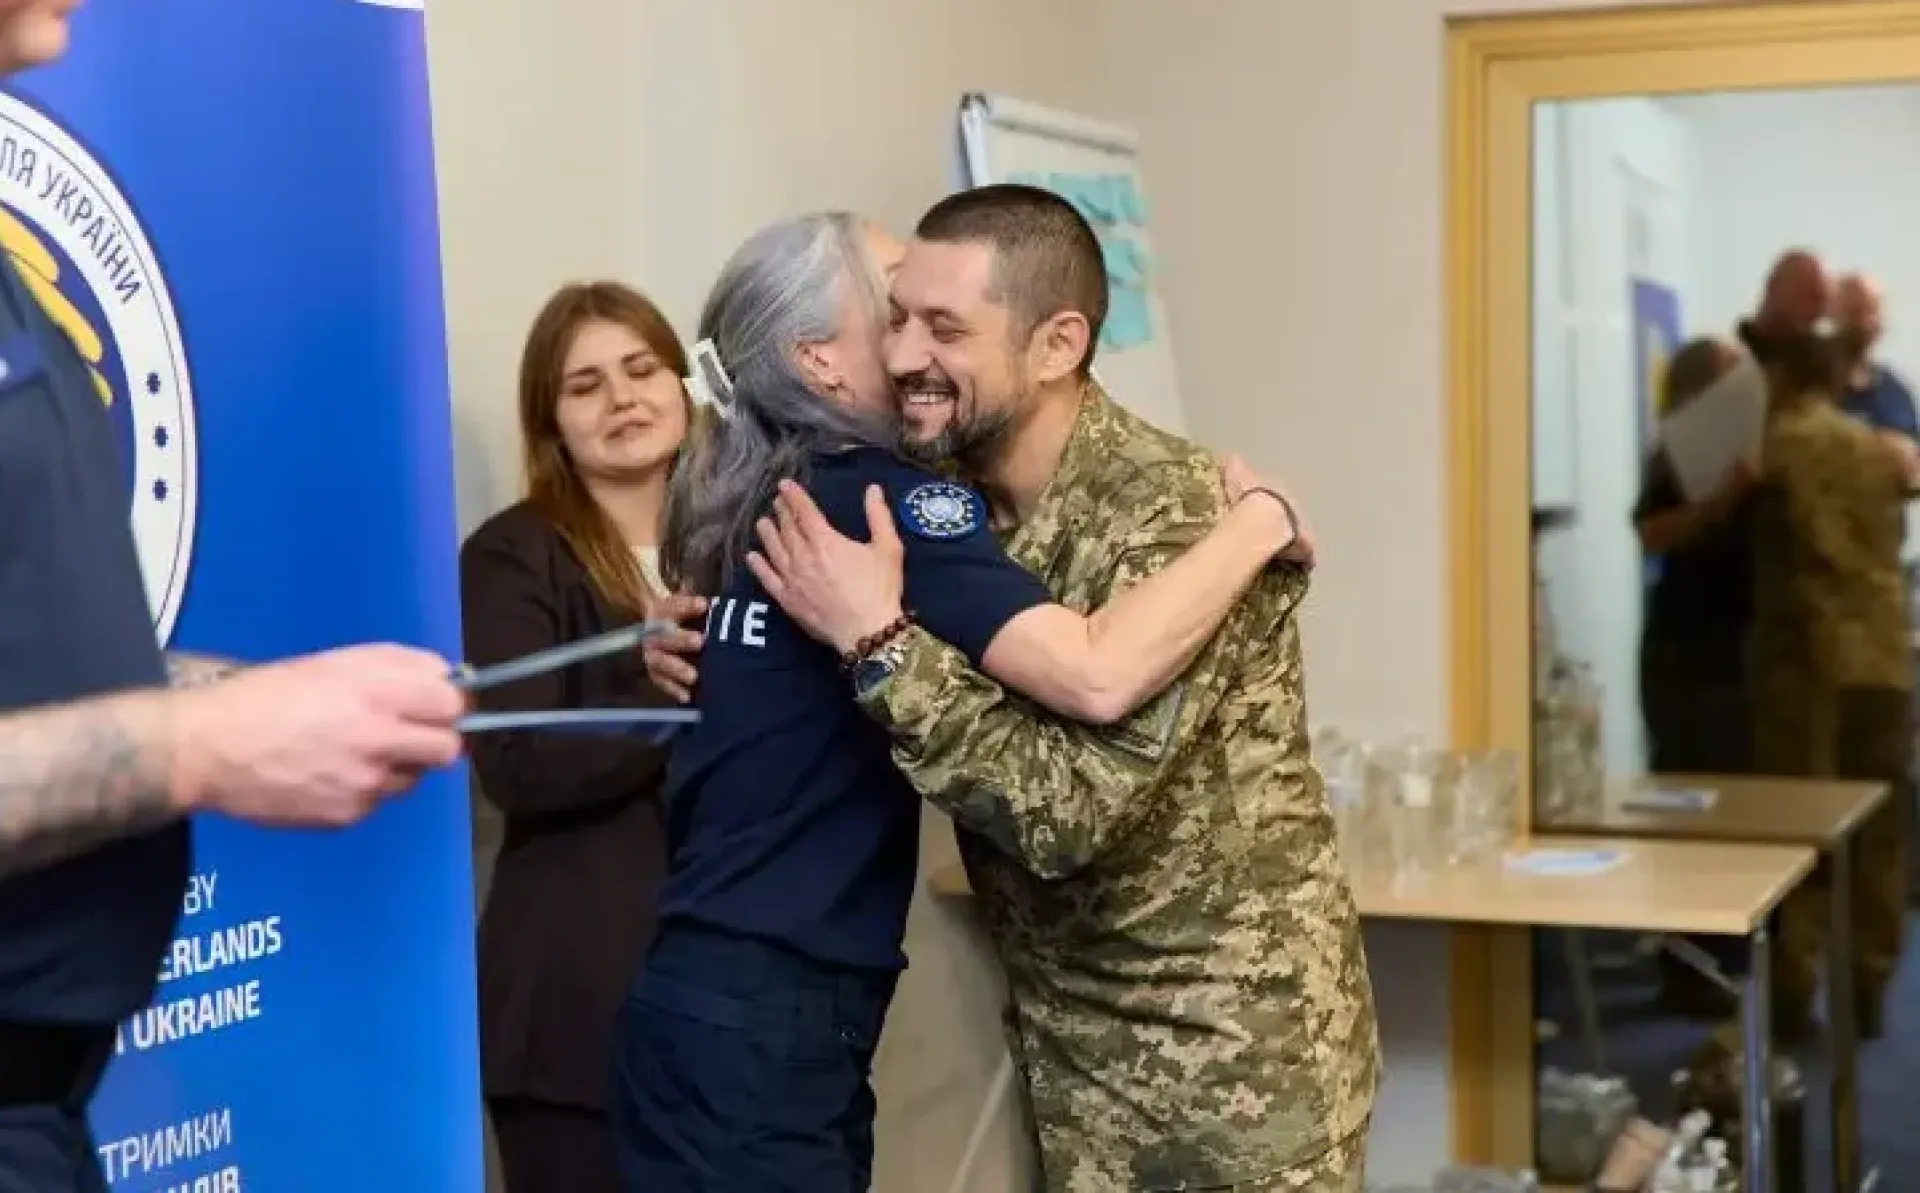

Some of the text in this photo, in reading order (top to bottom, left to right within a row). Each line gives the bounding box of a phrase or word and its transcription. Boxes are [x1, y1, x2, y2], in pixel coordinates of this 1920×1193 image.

[38, 163, 141, 304] УКРАЇНИ
[131, 979, 262, 1050] UKRAINE
[98, 1107, 232, 1184] ТРИМКИ
